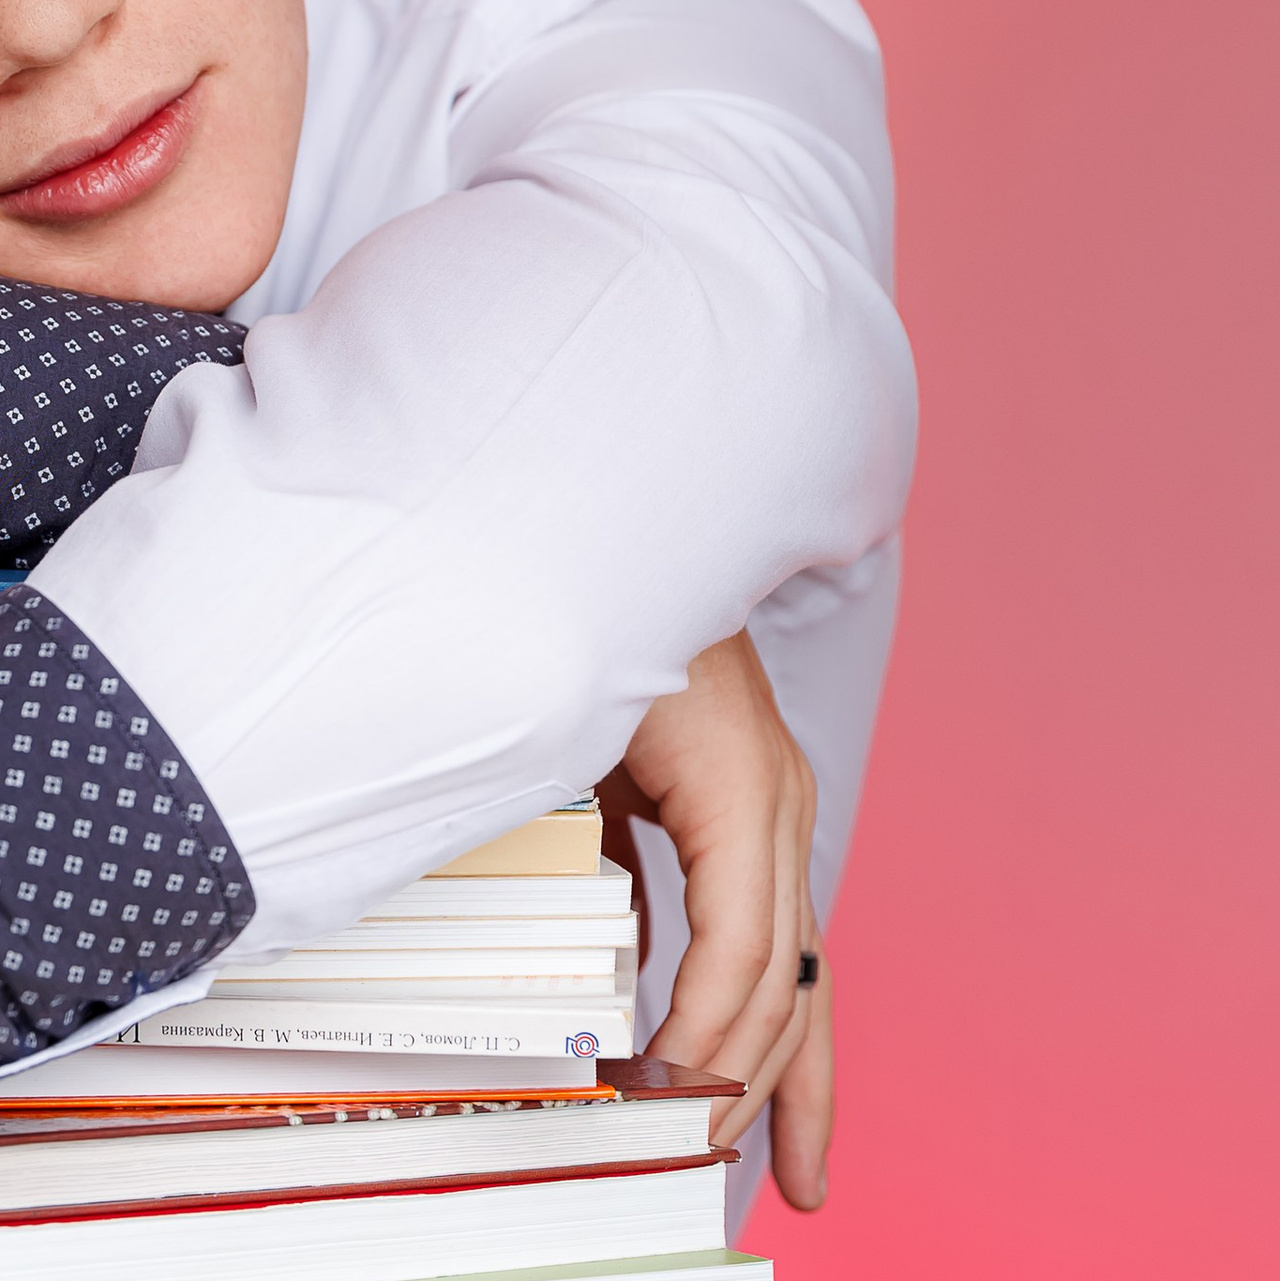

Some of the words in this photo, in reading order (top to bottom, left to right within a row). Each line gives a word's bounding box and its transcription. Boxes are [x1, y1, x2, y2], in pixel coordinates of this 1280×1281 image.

[161, 1023, 245, 1042] Кармазина
[249, 1027, 265, 1042] В.
[270, 1028, 291, 1043] М.
[296, 1028, 373, 1046] Игнатьев,
[378, 1032, 394, 1047] Е.
[399, 1033, 415, 1048] С.
[420, 1033, 477, 1050] Ломов,
[481, 1036, 499, 1051] П.
[504, 1037, 521, 1052] С.
